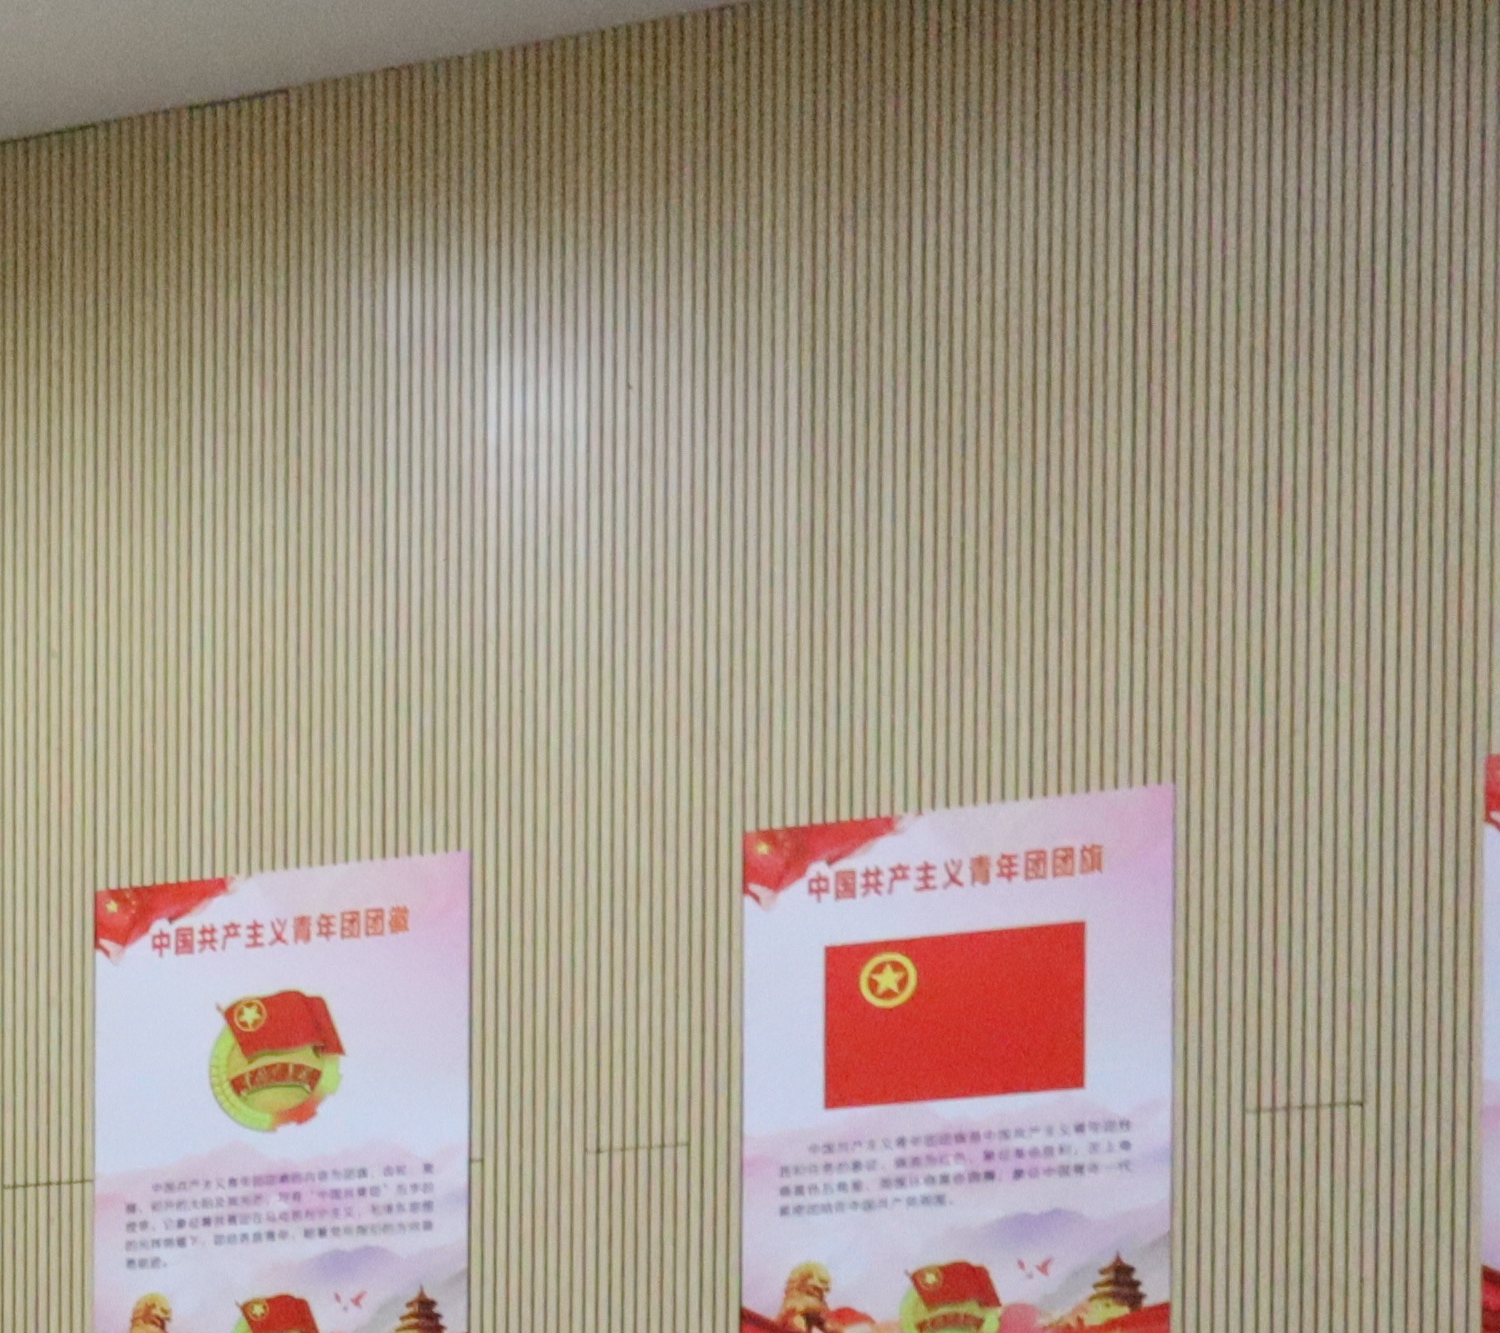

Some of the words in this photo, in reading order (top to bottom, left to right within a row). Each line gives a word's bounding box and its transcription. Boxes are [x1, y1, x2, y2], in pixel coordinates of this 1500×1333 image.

[807, 843, 1104, 903] 中国共产主义青年团团旗
